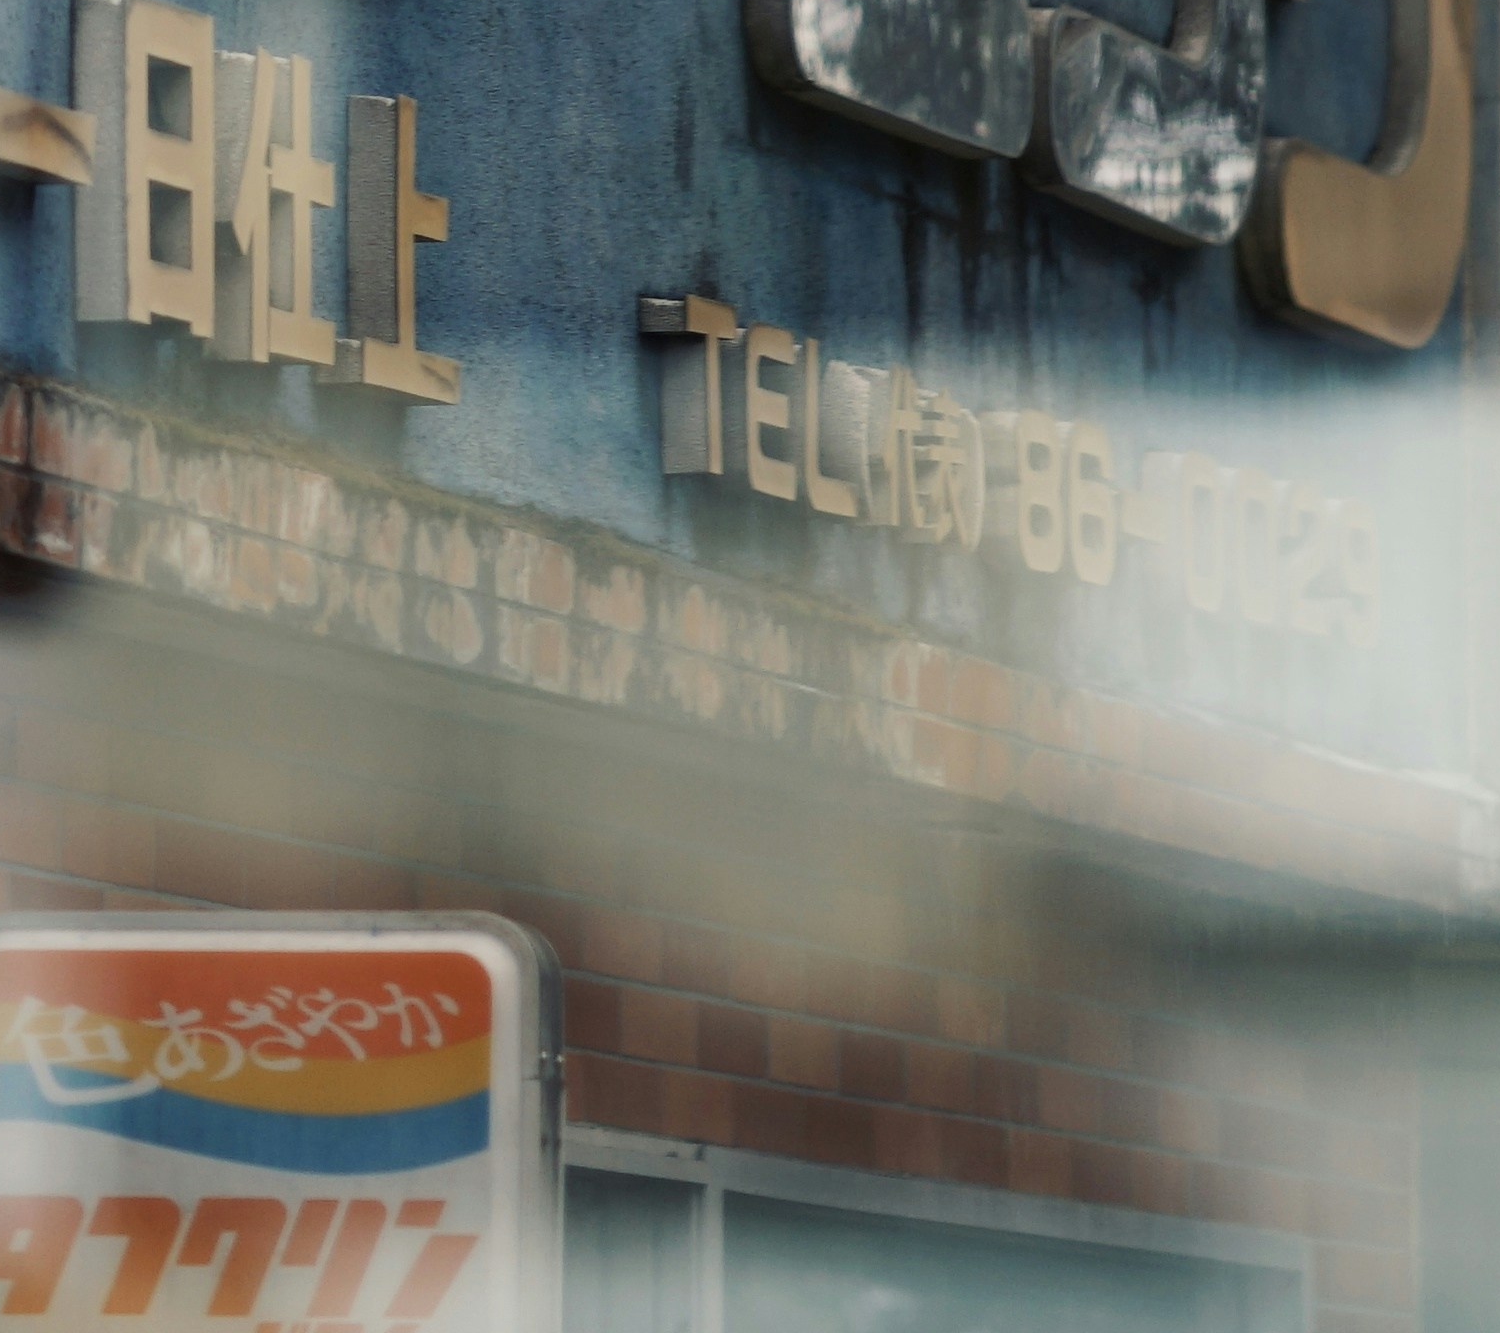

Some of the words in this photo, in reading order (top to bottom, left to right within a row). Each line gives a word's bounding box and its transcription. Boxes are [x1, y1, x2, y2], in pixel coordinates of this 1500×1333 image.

[3, 980, 462, 1108] 色あざやか
